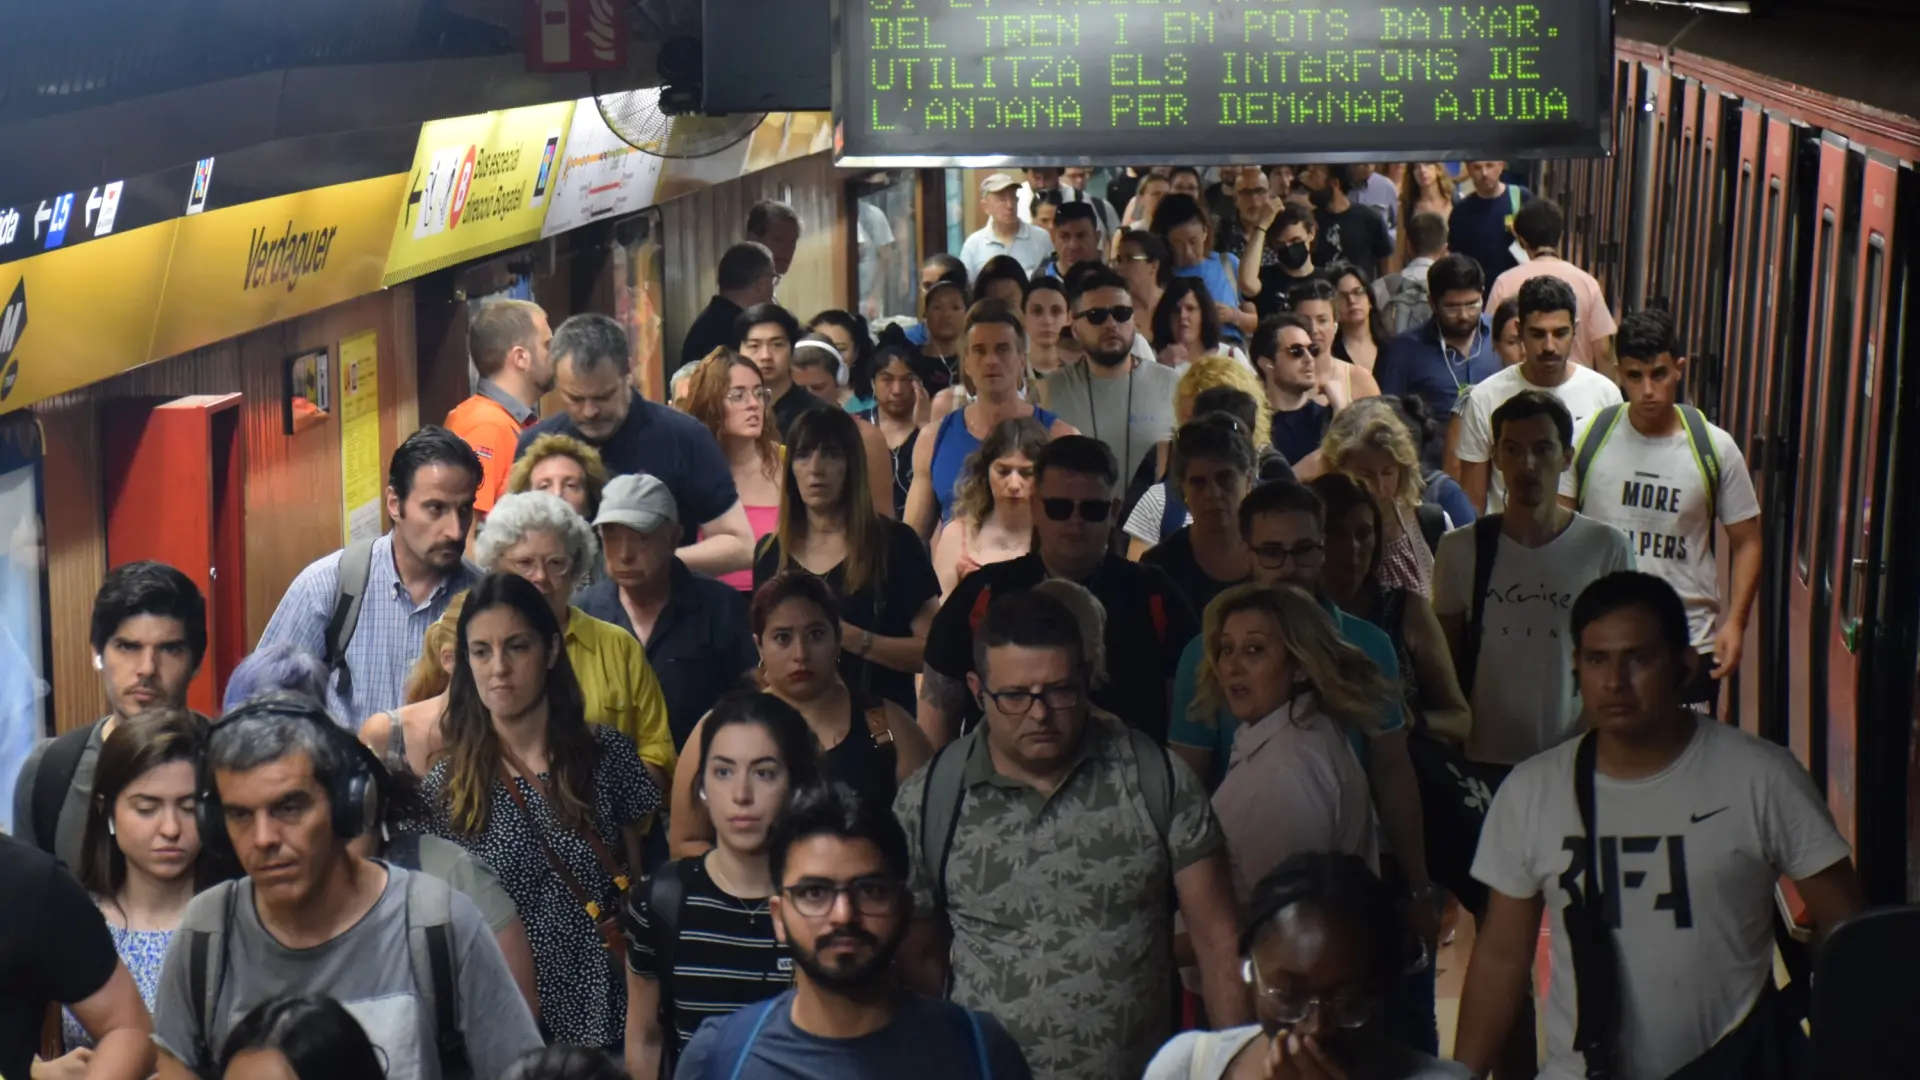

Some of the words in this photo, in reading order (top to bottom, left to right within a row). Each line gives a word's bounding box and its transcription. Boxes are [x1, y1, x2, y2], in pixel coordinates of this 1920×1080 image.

[871, 17, 946, 49] DEL
[977, 13, 1080, 47] TREN
[1114, 13, 1128, 45] I
[1163, 11, 1213, 44] EN
[1244, 9, 1349, 42] POTS
[1380, 5, 1558, 40] BAIXAR.
[871, 54, 1081, 91] UTILITZA
[1111, 53, 1188, 86] ELS
[1489, 46, 1541, 79] DE
[1111, 93, 1188, 127] PER
[1218, 89, 1404, 125] DEMANAR
[1434, 87, 1568, 120] AJUDA
[473, 147, 491, 180] Bus
[488, 140, 524, 182] especial
[50, 193, 74, 233] L5
[243, 219, 338, 293] Verdaguer
[1621, 480, 1682, 514] MORE
